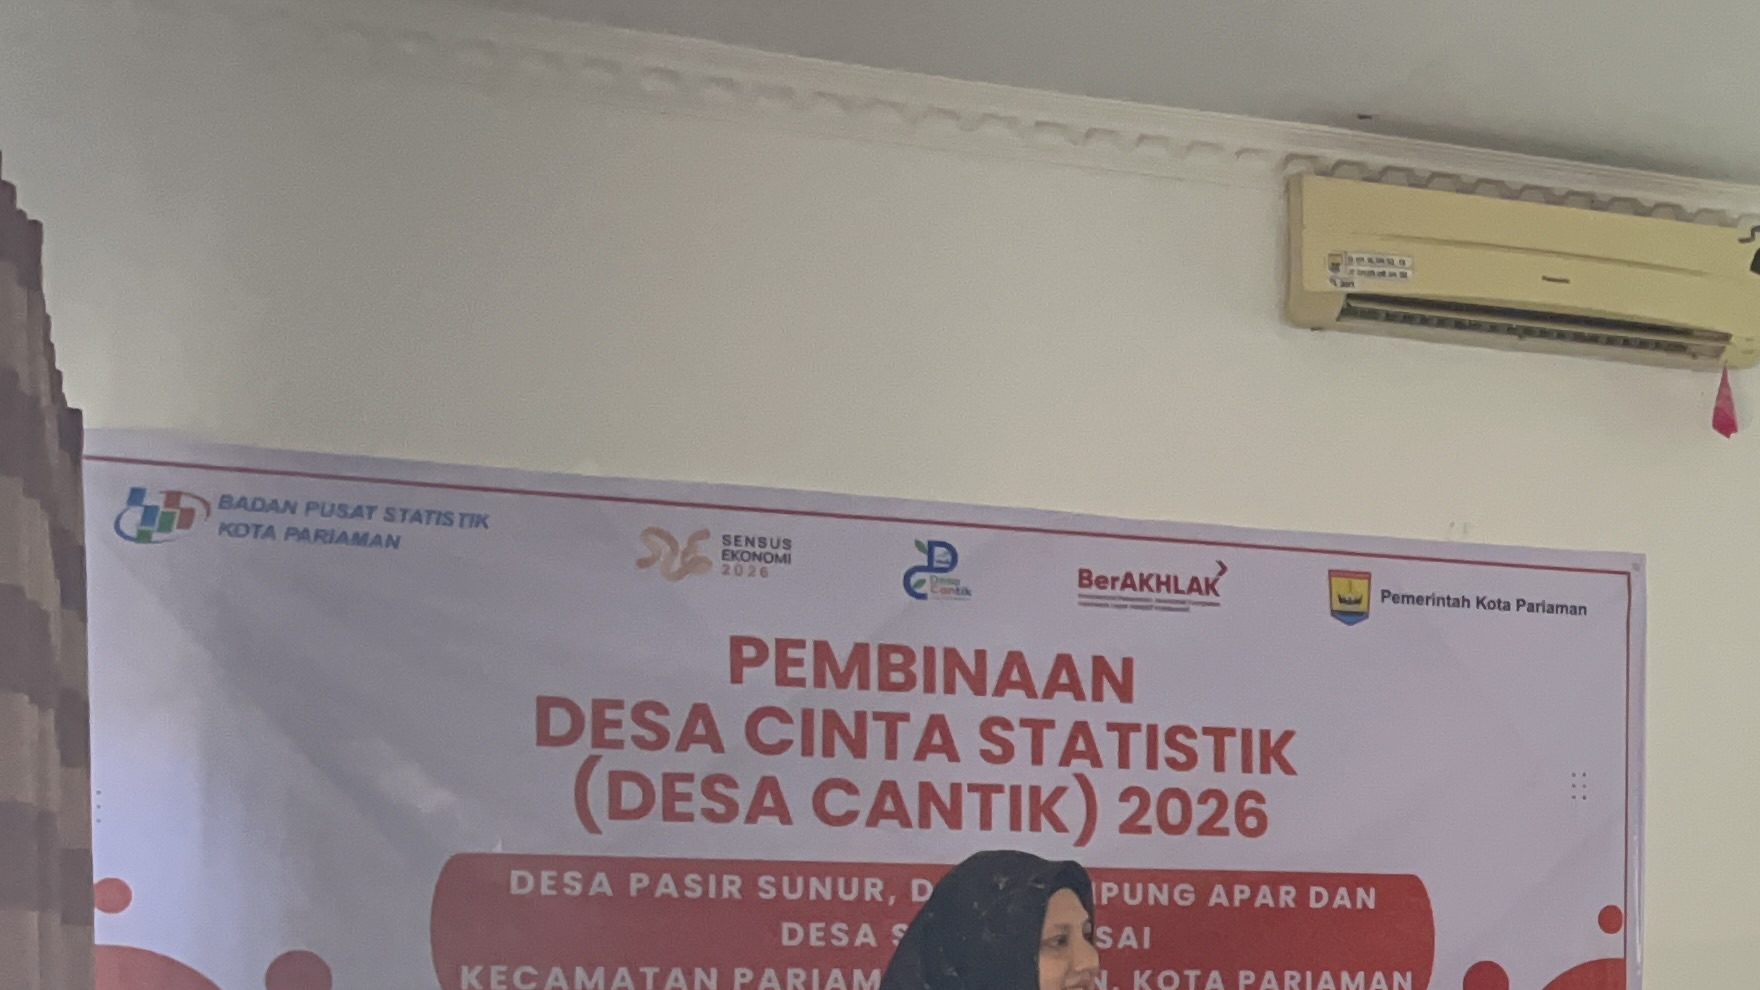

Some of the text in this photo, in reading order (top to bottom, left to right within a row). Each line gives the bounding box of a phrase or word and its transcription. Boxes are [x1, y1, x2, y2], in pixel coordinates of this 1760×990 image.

[218, 494, 490, 530] BADAN PUSAT STATISTIK
[218, 522, 401, 550] KOTA PARIAMAN
[722, 533, 793, 550] SENSUS
[722, 549, 793, 565] EKONOMI
[722, 564, 769, 579] 2026
[1078, 567, 1220, 597] BerAKHLAK
[1381, 590, 1588, 616] Pemerintah Kota Pariaman
[729, 635, 1135, 703] PEMBINAAN
[535, 695, 1297, 776] DESA CINTA STATISTIK
[575, 755, 1268, 847] (DESA CANTIK) 2026
[510, 868, 613, 898] DESA
[629, 870, 743, 900] PASIR
[759, 874, 896, 906] SUNUR,
[1094, 881, 1376, 910] PUNG APAR DAN
[781, 922, 878, 947] DESA
[1096, 925, 1151, 951] SAI
